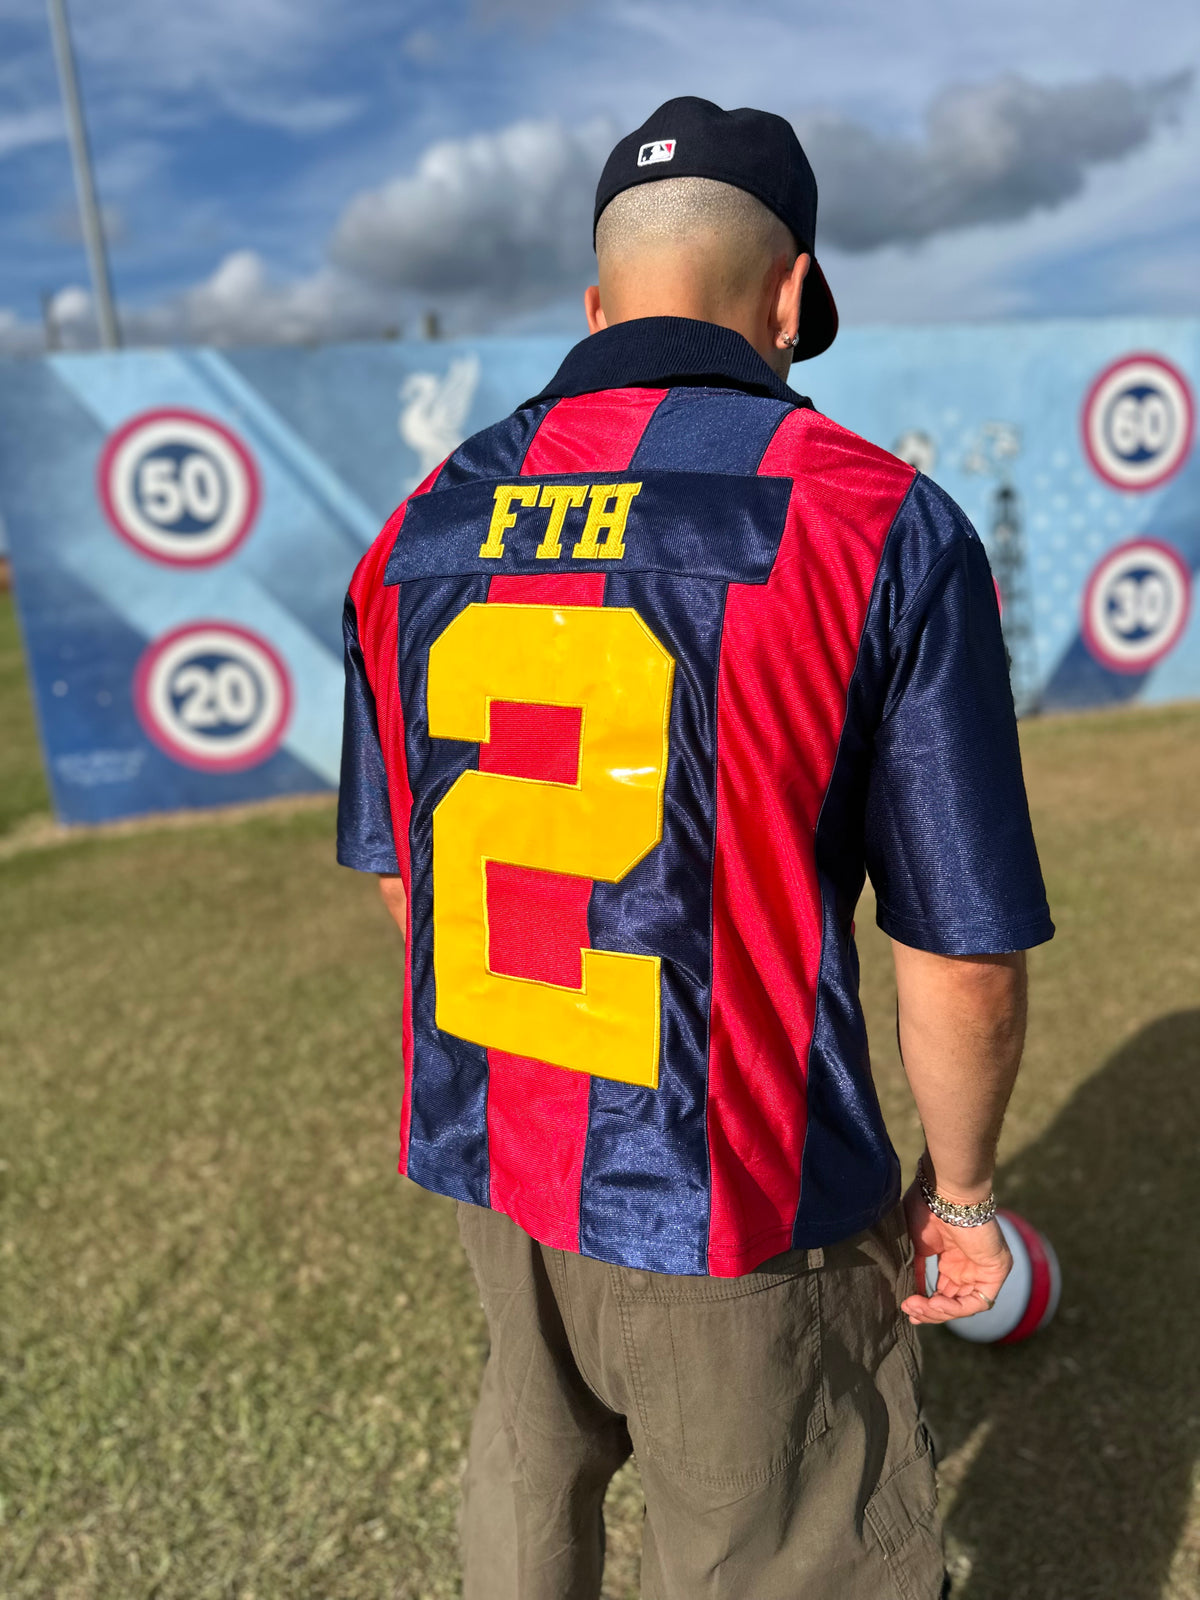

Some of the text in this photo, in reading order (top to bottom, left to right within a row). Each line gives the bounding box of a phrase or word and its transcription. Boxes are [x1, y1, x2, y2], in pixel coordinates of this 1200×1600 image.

[1111, 394, 1167, 456] 60
[140, 456, 221, 524] 50
[479, 481, 642, 560] FTH
[1112, 574, 1165, 635] 30
[175, 662, 257, 729] 20
[427, 602, 675, 1090] 2
